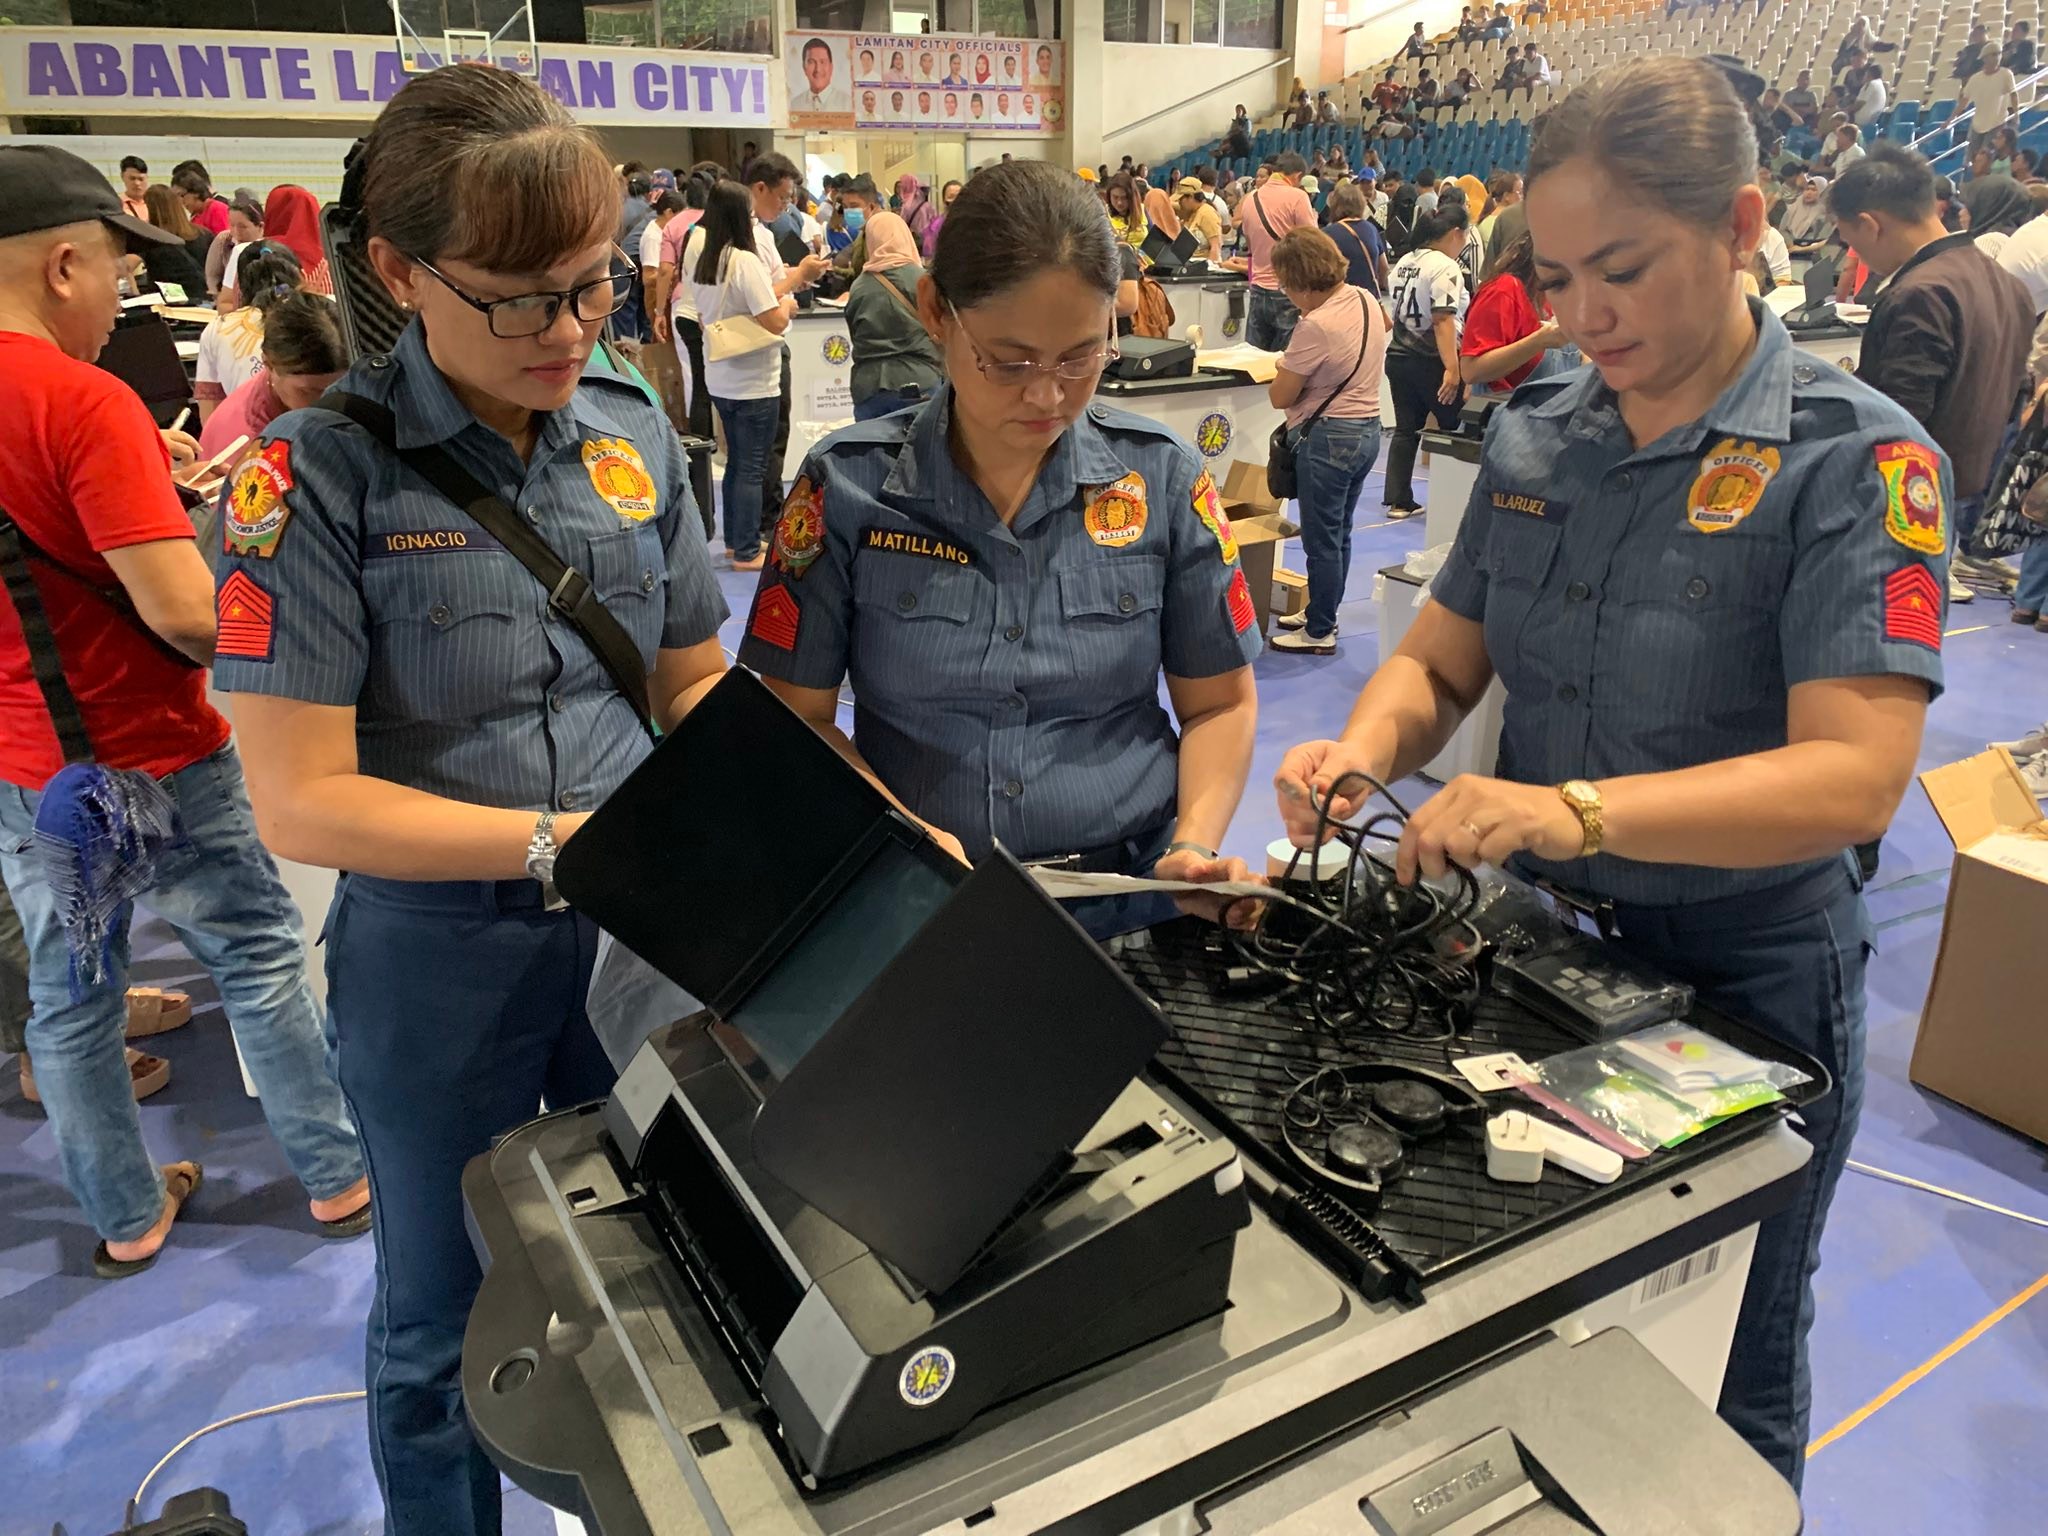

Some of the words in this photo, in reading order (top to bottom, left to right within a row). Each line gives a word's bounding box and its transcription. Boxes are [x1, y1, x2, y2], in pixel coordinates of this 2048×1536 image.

[855, 36, 914, 49] LAMITAN
[920, 39, 950, 50] CITY
[956, 41, 1022, 53] OFFICIALS
[28, 42, 317, 100] ABANTE
[332, 49, 616, 109] LAAN
[632, 61, 766, 114] CITY!
[590, 449, 634, 464] OFFICER
[1713, 455, 1769, 475] OFFICER
[386, 531, 467, 551] IGNACIO
[869, 530, 969, 564] MATILLANO
